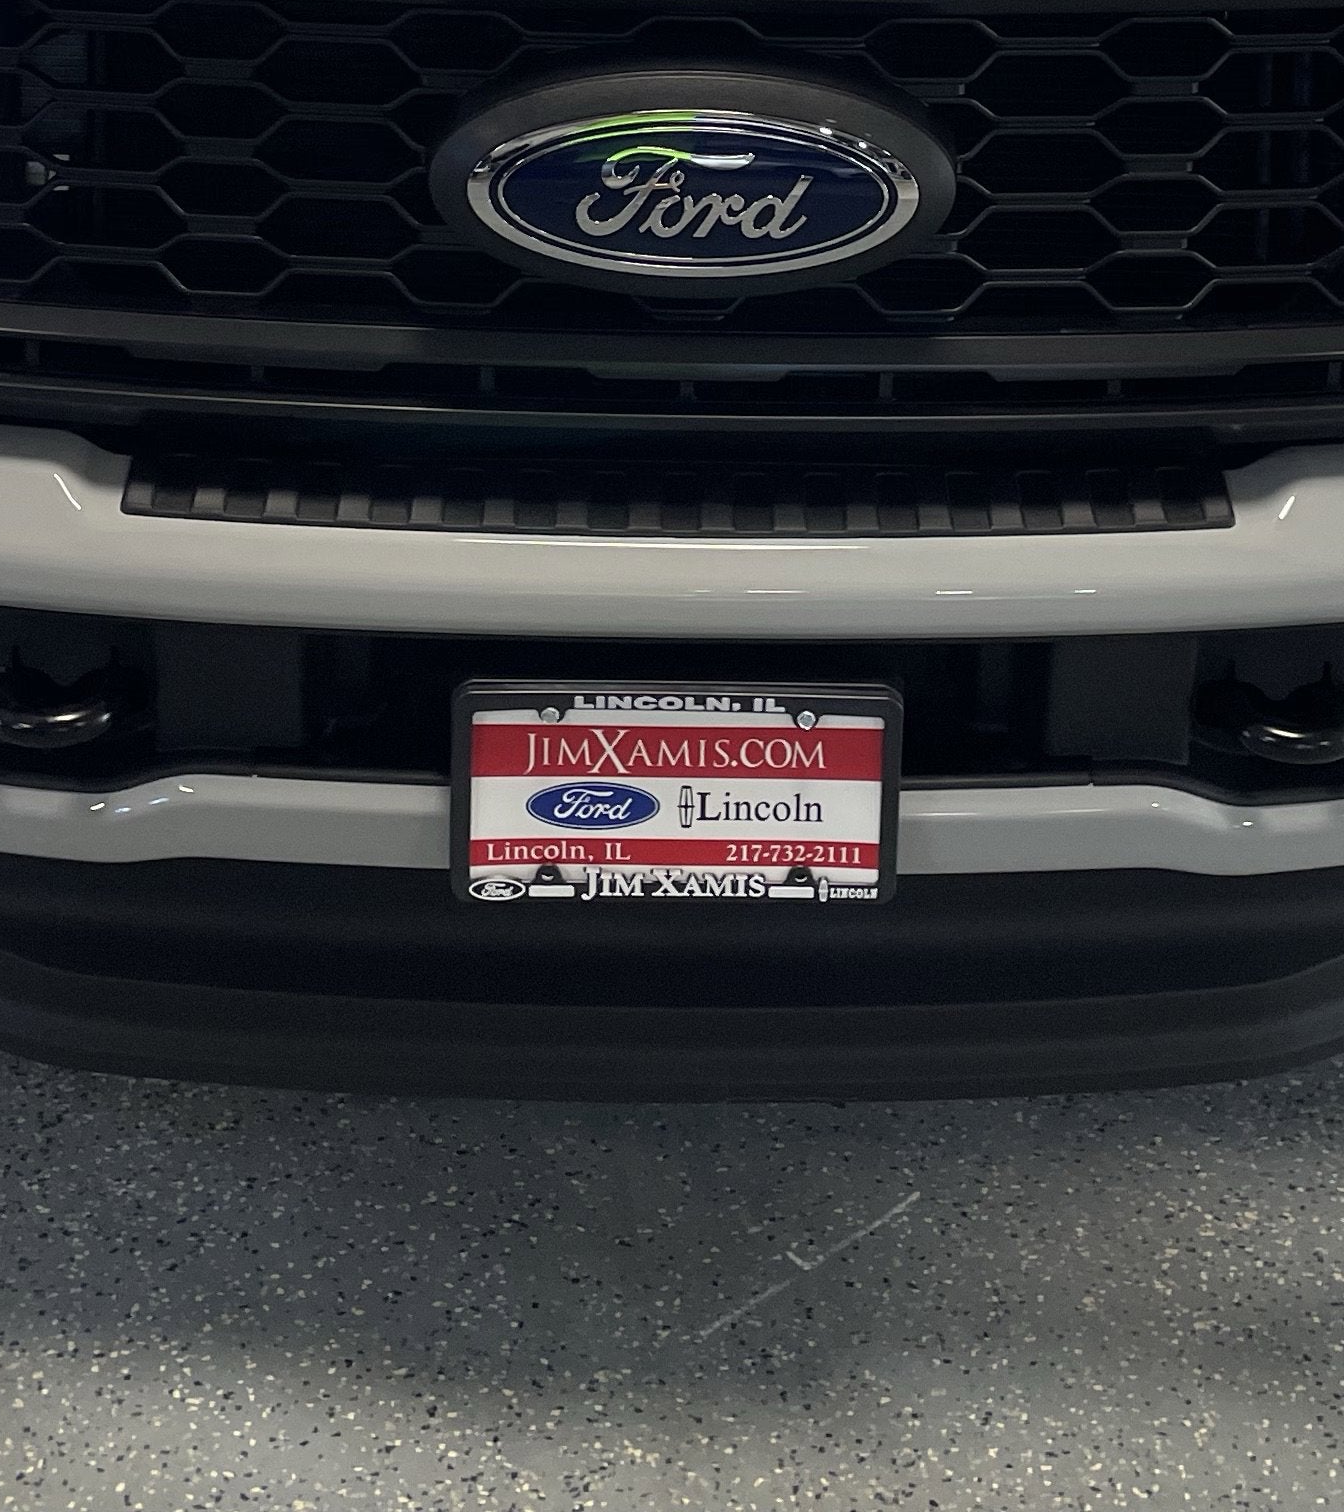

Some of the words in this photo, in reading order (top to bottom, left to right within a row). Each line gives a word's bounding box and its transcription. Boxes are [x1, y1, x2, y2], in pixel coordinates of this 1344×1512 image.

[575, 146, 814, 239] Ford
[573, 695, 741, 712] LINCOLN,
[753, 697, 786, 713] IL
[523, 728, 827, 776] JIMXAMIS.COM
[554, 788, 632, 821] Ford
[696, 791, 824, 823] Lincoln
[486, 842, 594, 863] Lincoln,
[604, 843, 632, 861] IL
[726, 844, 862, 865] 217-732-2111
[581, 866, 644, 901] JIM
[651, 868, 766, 899] XAMIS
[830, 887, 879, 900] LINCOLN
